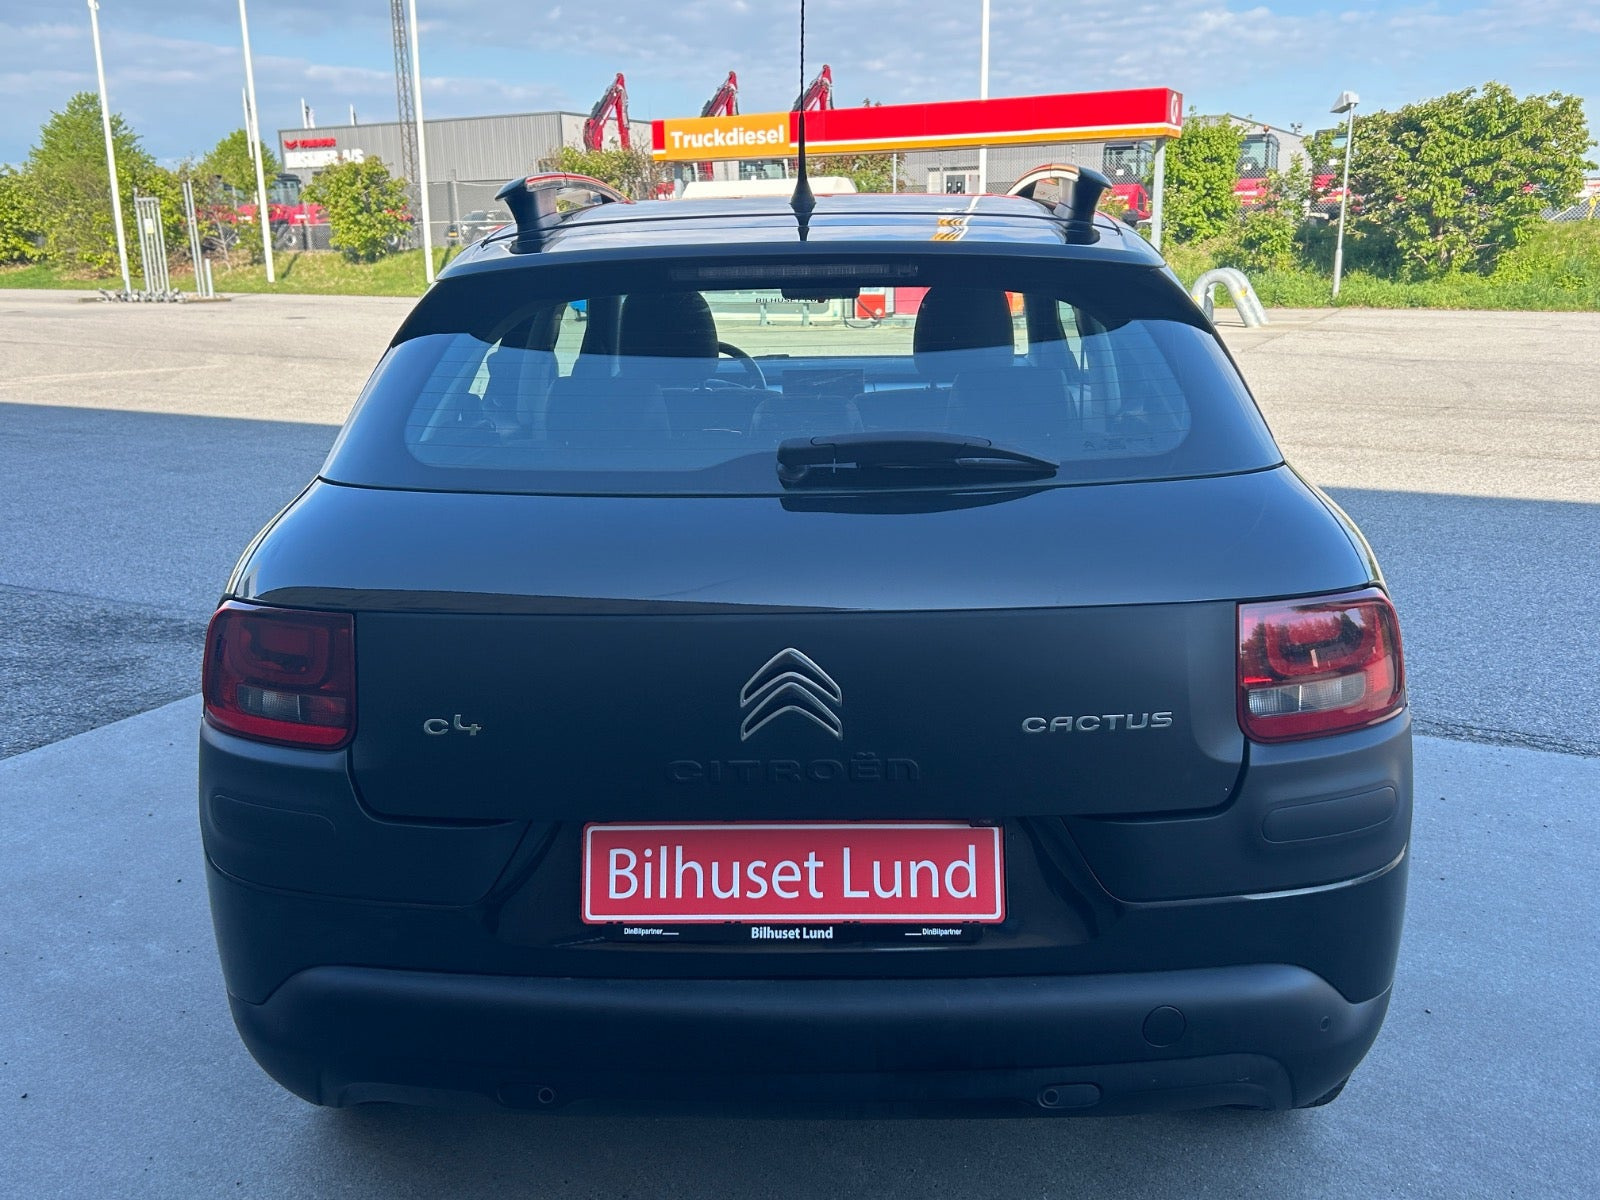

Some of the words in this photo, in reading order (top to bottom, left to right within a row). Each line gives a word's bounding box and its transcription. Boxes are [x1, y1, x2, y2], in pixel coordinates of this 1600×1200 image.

[670, 124, 784, 149] Truckdiesel
[423, 714, 482, 736] C4
[1021, 711, 1173, 733] CACTUS
[607, 845, 824, 900] Bilhuset
[842, 844, 978, 899] Lund
[751, 926, 800, 939] Bilhuset
[802, 926, 833, 939] Lund
